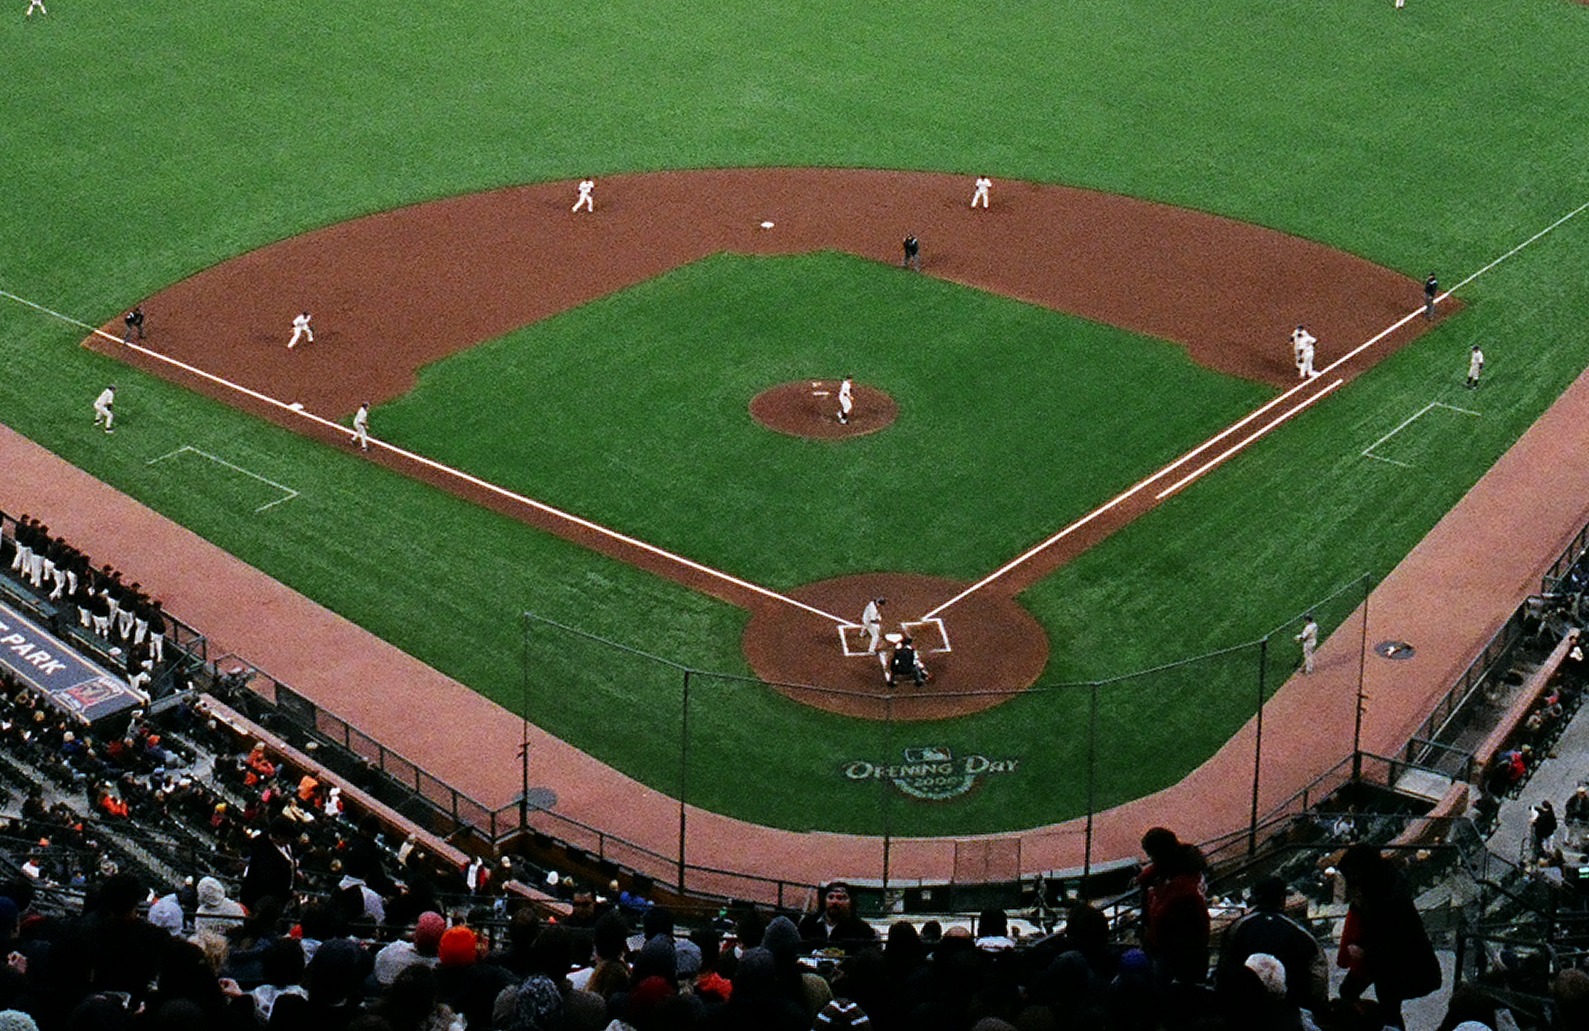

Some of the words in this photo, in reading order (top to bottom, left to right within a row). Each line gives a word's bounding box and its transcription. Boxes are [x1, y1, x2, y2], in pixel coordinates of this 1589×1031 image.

[0, 632, 67, 676] PARK
[843, 760, 953, 780] OPENING
[962, 754, 1019, 774] DAY
